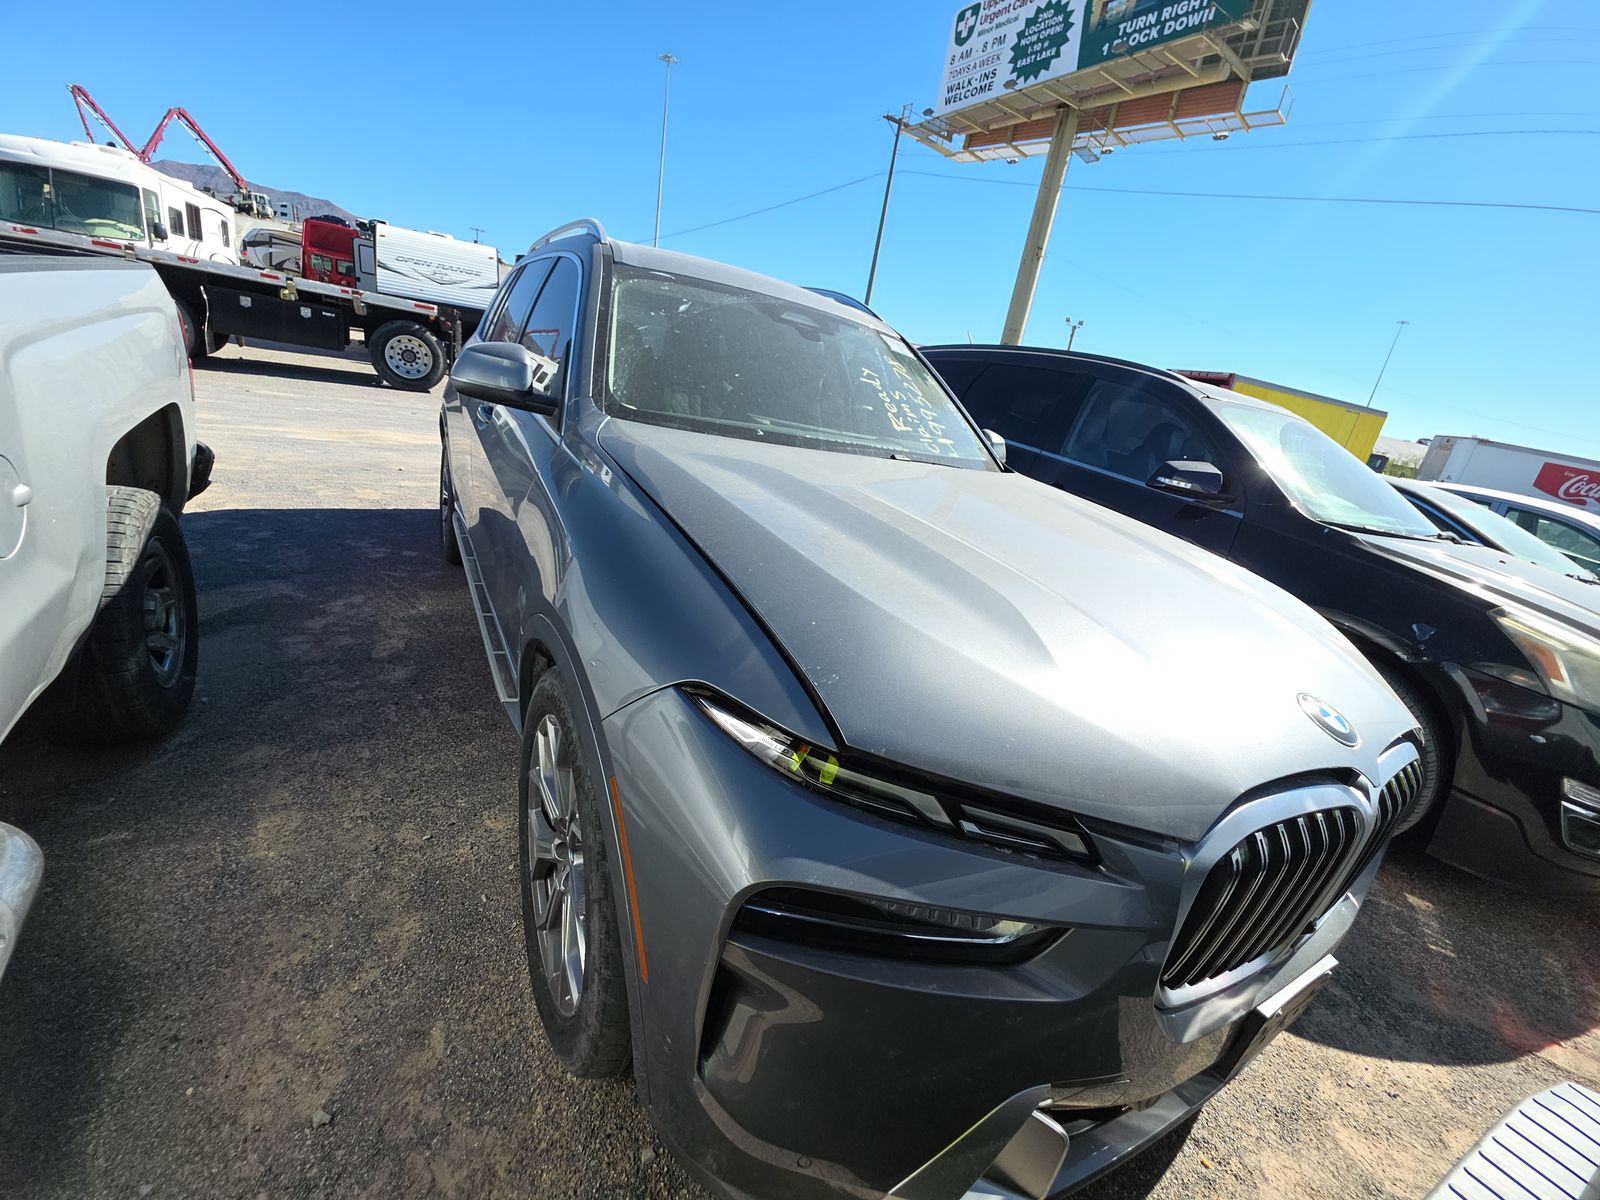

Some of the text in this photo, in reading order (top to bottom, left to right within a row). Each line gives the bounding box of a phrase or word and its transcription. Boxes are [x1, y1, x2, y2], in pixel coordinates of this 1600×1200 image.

[980, 3, 1011, 25] Urgent
[983, 0, 1005, 11] Upp
[1038, 9, 1055, 22] 2ND
[977, 13, 1020, 37] Minor Medical
[1025, 14, 1064, 36] LOCATION
[1119, 11, 1158, 36] TURN
[1020, 23, 1064, 47] NOW OPEN!
[1102, 43, 1109, 56] 1
[1112, 25, 1161, 52] OCK
[950, 54, 956, 66] 8
[958, 47, 973, 62] AM
[982, 41, 989, 53] 8
[991, 33, 1007, 49] PM
[979, 52, 1001, 69] WEEK
[1017, 47, 1057, 68] EAST LAKE
[945, 81, 994, 106] WELCOME
[396, 256, 482, 276] OPEN RANGE
